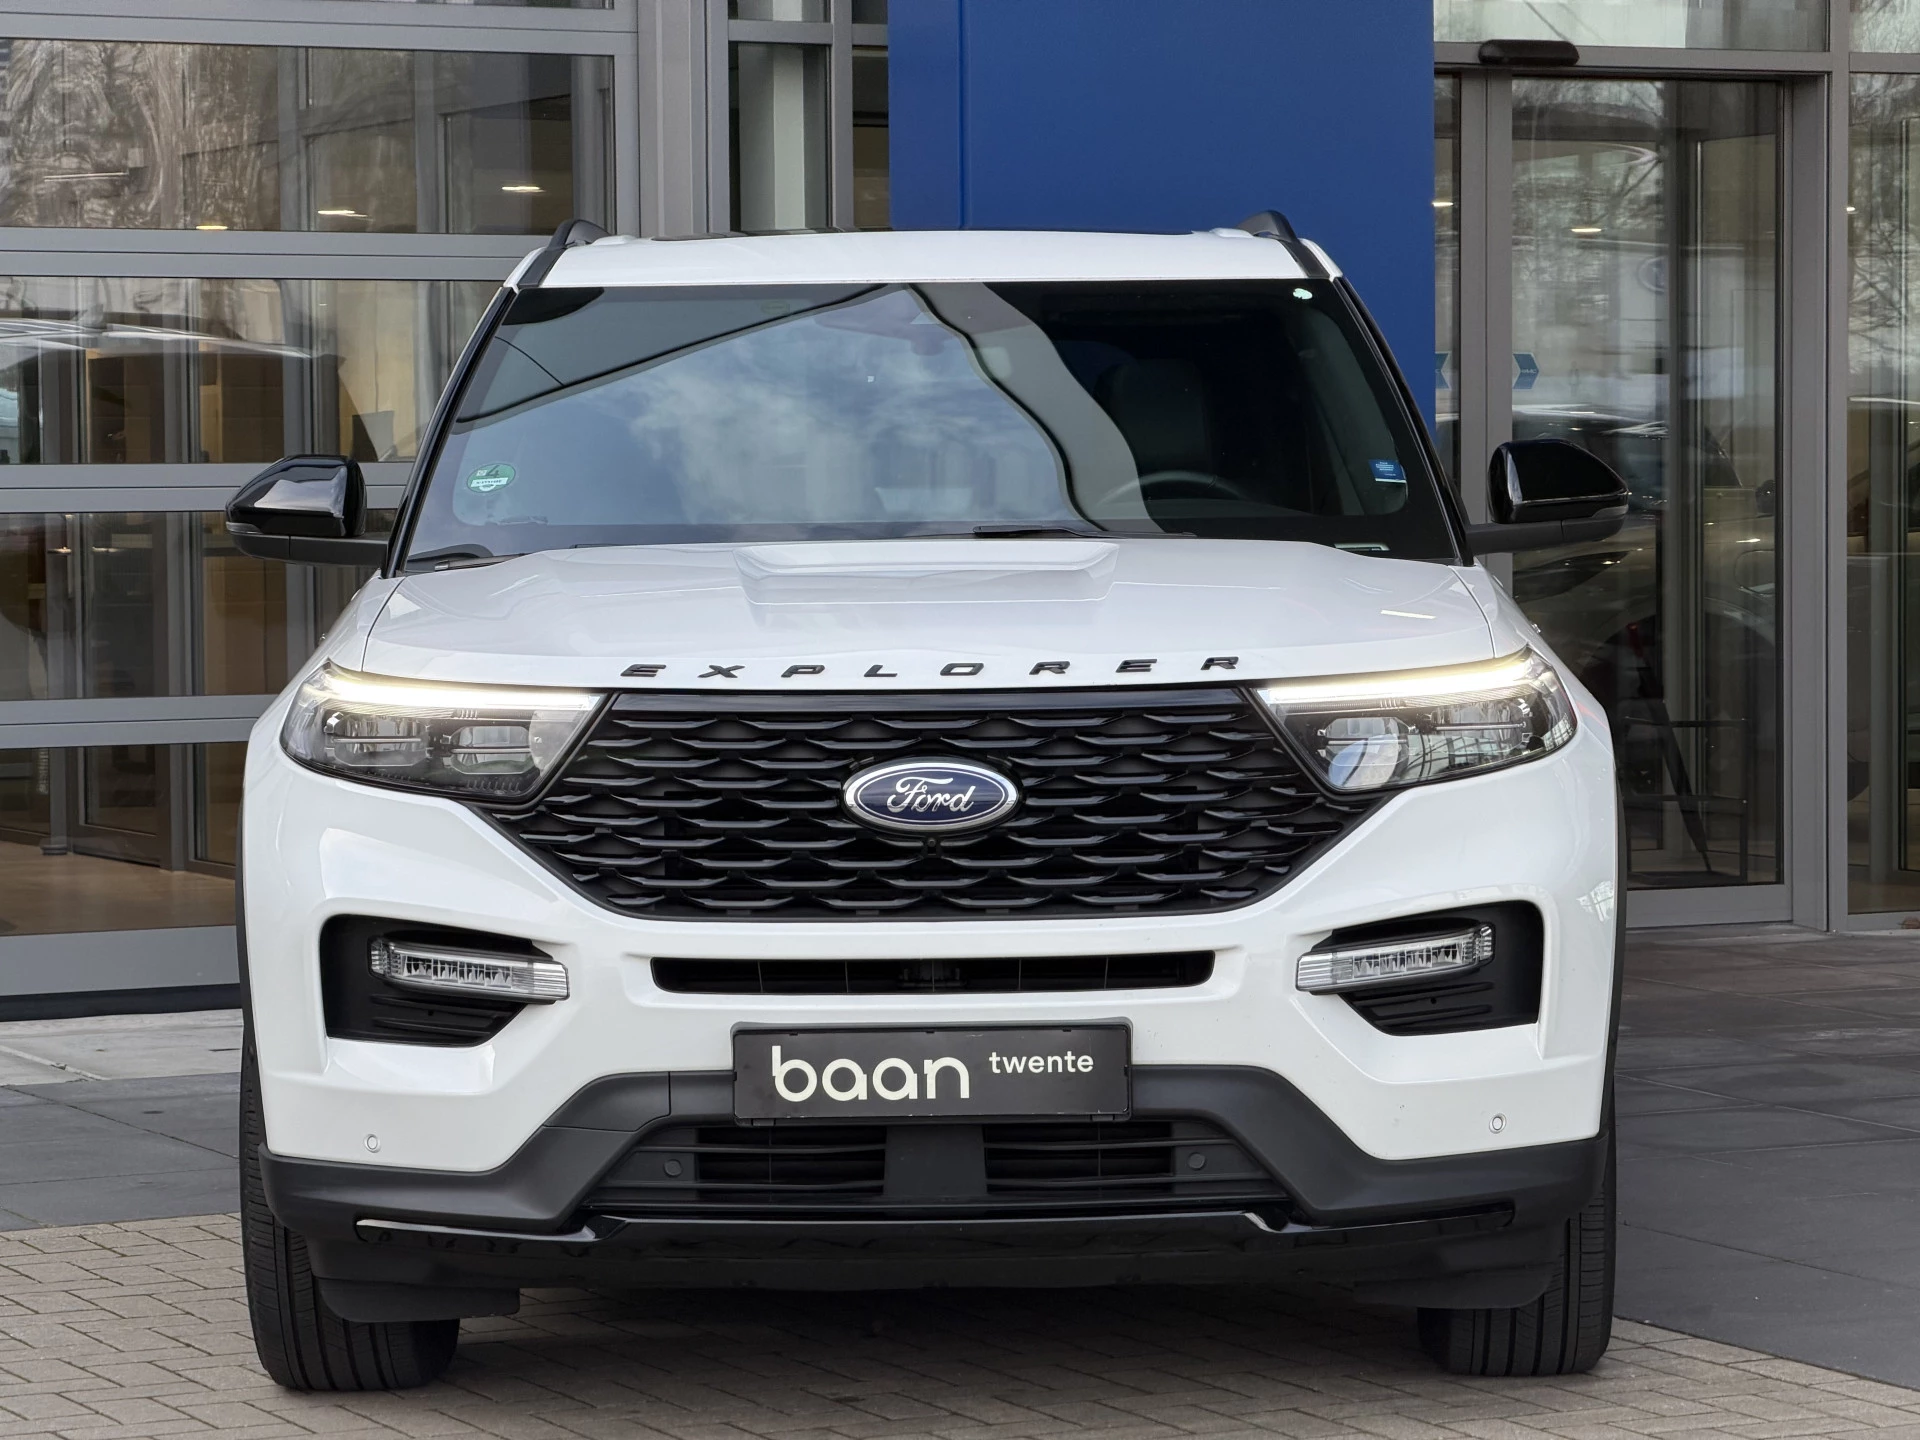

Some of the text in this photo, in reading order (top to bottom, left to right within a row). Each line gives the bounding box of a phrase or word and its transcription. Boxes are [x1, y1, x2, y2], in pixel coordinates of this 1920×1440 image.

[485, 464, 500, 478] 4
[620, 656, 1239, 678] EXPLORER
[886, 776, 976, 813] Ford
[772, 1045, 1094, 1102] baan twente
